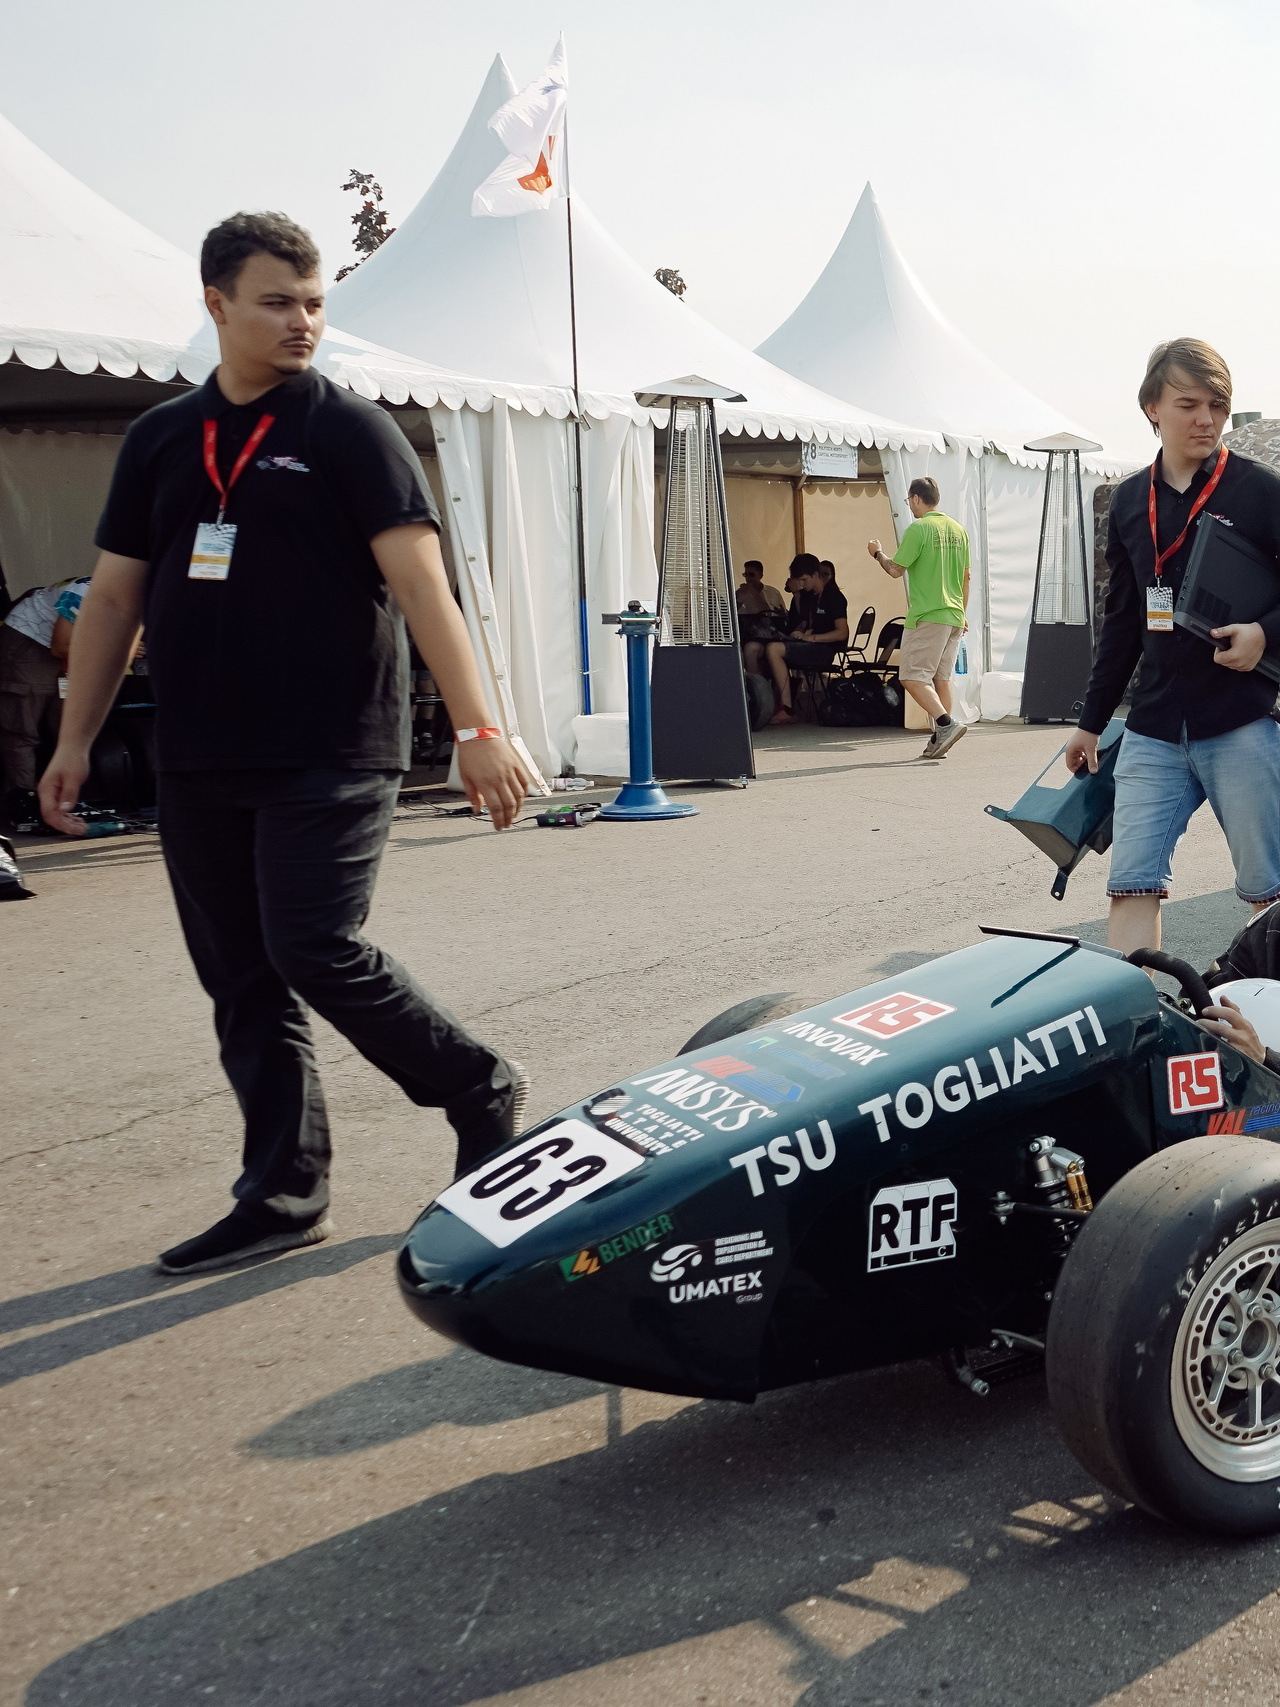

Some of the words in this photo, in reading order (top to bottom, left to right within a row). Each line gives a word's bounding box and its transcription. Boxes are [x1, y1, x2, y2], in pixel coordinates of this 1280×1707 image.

[803, 442, 817, 460] 78
[840, 994, 948, 1037] RS
[782, 1021, 890, 1067] INNOVAX
[630, 1068, 775, 1132] ANSYS
[729, 1119, 837, 1198] TSU
[857, 1005, 1108, 1143] TOGLIATTI
[1170, 1056, 1221, 1110] RS
[604, 1117, 674, 1156] UNIVERSITY
[635, 1103, 706, 1142] TOGLIATTI
[1207, 1109, 1246, 1135] VAL
[469, 1135, 607, 1221] 63
[598, 1213, 675, 1264] BENDER
[870, 1192, 955, 1253] RTF
[669, 1270, 763, 1304] UMATEX
[736, 1291, 763, 1304] Group
